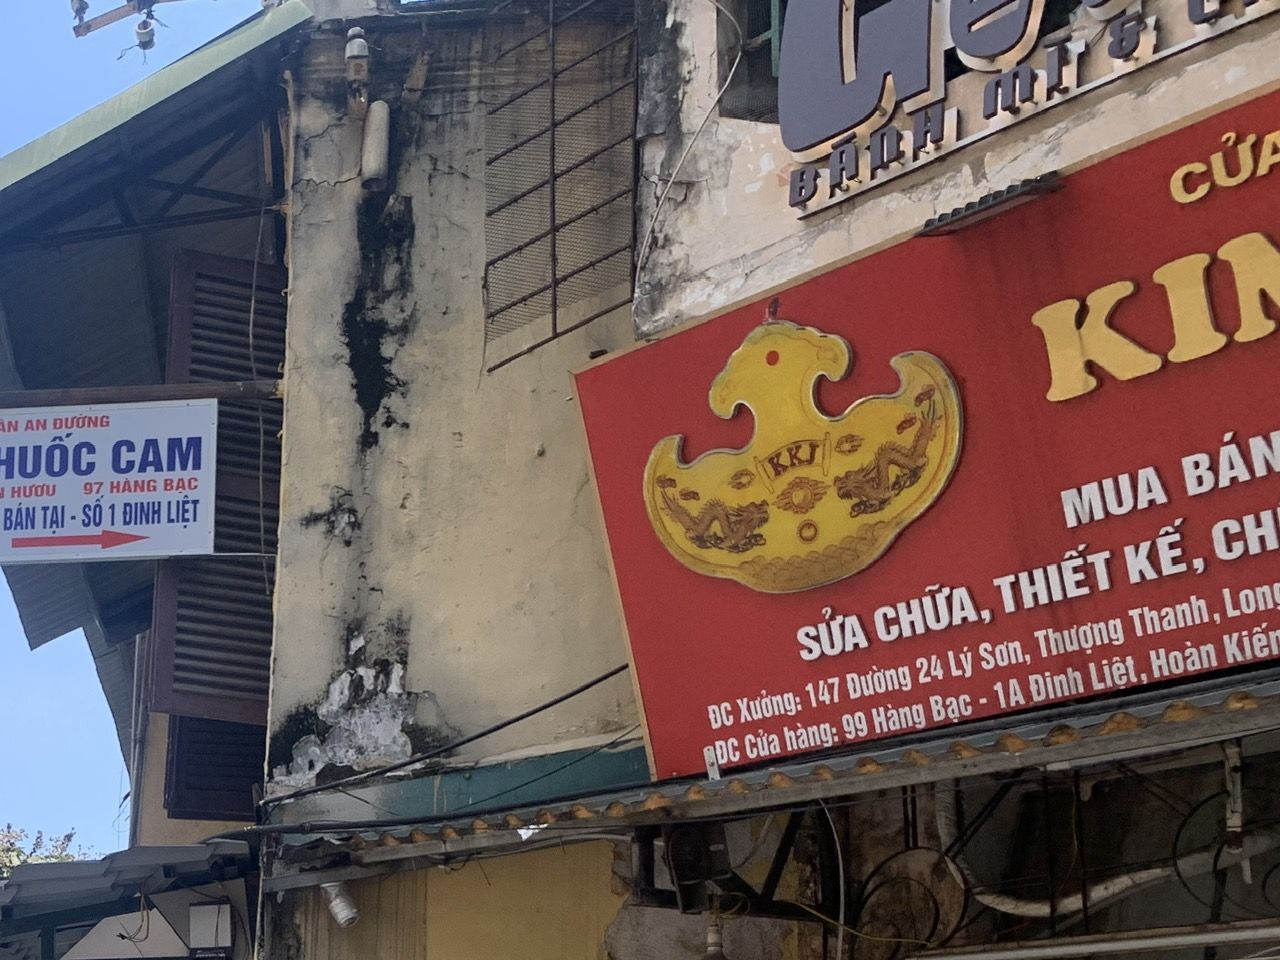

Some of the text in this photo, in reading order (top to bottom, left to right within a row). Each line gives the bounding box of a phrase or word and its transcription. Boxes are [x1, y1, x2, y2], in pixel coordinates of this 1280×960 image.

[24, 419, 47, 431] AN
[112, 436, 202, 475] CAM
[11, 484, 56, 498] HƯƠU
[83, 482, 104, 495] 97
[110, 478, 157, 493] HÀNG
[163, 477, 198, 493] BẠC
[1060, 431, 1280, 528] MUA BÁN
[4, 502, 38, 530] BÁN
[42, 505, 65, 534] TẠI
[82, 495, 103, 527] SỐ
[109, 504, 115, 526] 1
[123, 501, 161, 525] ĐINH
[167, 495, 200, 528] LIỆT
[797, 607, 869, 661] SỬA
[993, 543, 1112, 614] THIẾT
[1212, 506, 1280, 561] CH
[736, 689, 802, 724] Xưởng:
[806, 677, 839, 707] 147
[846, 665, 912, 699] Đường
[916, 655, 944, 684] 24
[948, 646, 972, 678] Lý
[1034, 617, 1124, 654] Thượng
[744, 728, 781, 758] Cửa
[783, 722, 838, 752] hàng:
[842, 711, 868, 739] 99
[871, 702, 926, 733] Hàng
[929, 694, 972, 723] Bạc
[994, 678, 1025, 710] 1A
[1029, 667, 1084, 701] Đinh
[1150, 641, 1217, 679] Hoàn
